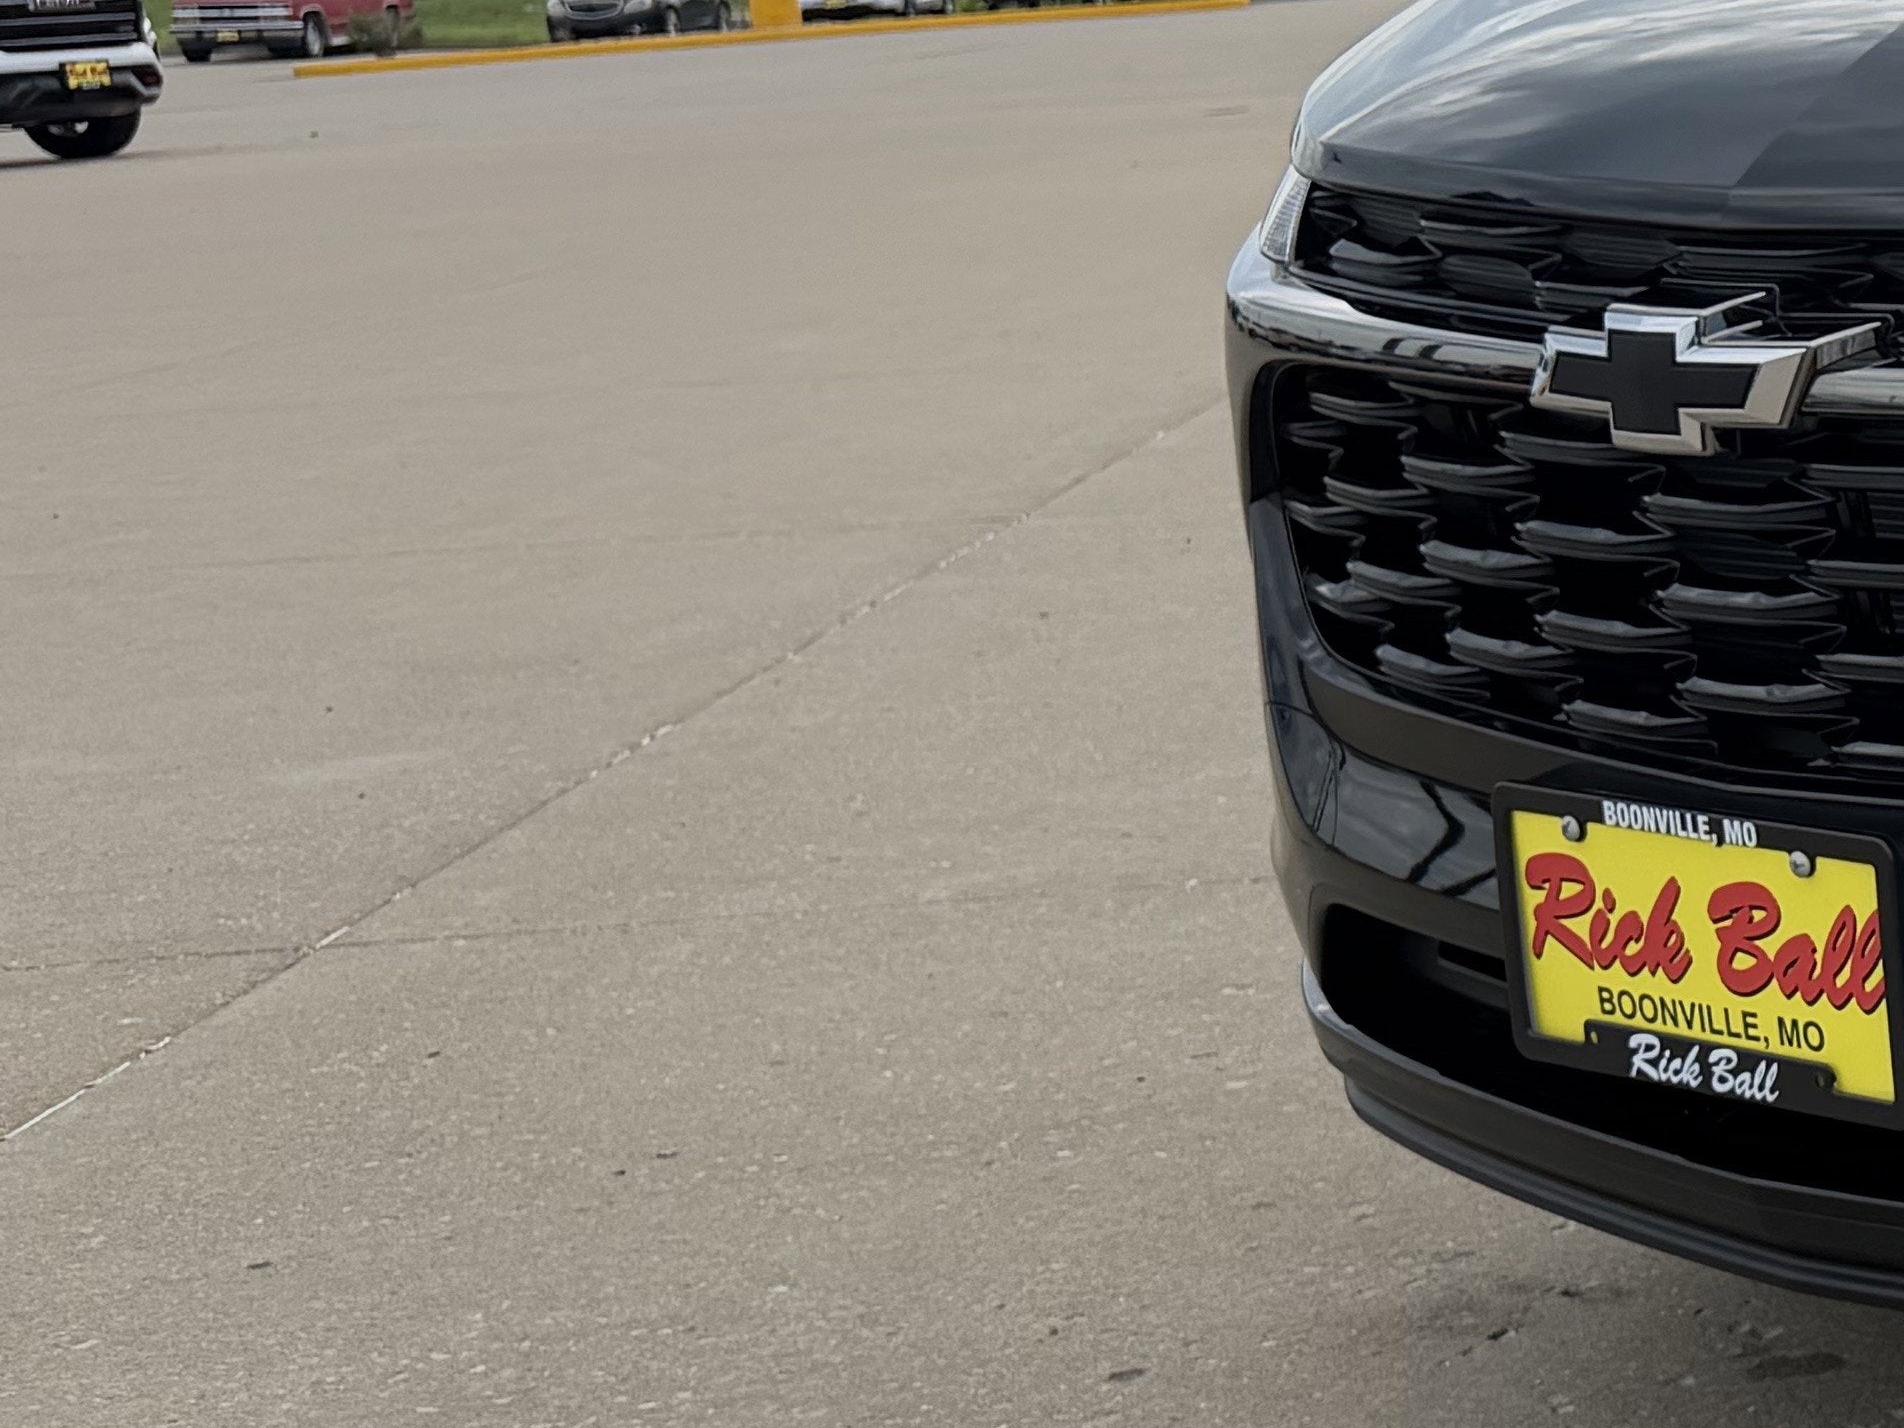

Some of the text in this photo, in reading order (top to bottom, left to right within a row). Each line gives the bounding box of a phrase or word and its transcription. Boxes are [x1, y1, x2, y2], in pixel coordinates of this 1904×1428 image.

[1602, 800, 1757, 849] BOONVILLE, MO
[1525, 852, 1888, 1014] Rick Ball
[1597, 986, 1825, 1053] BOONVILLE, MO
[1627, 1032, 1779, 1104] Rick Ball
